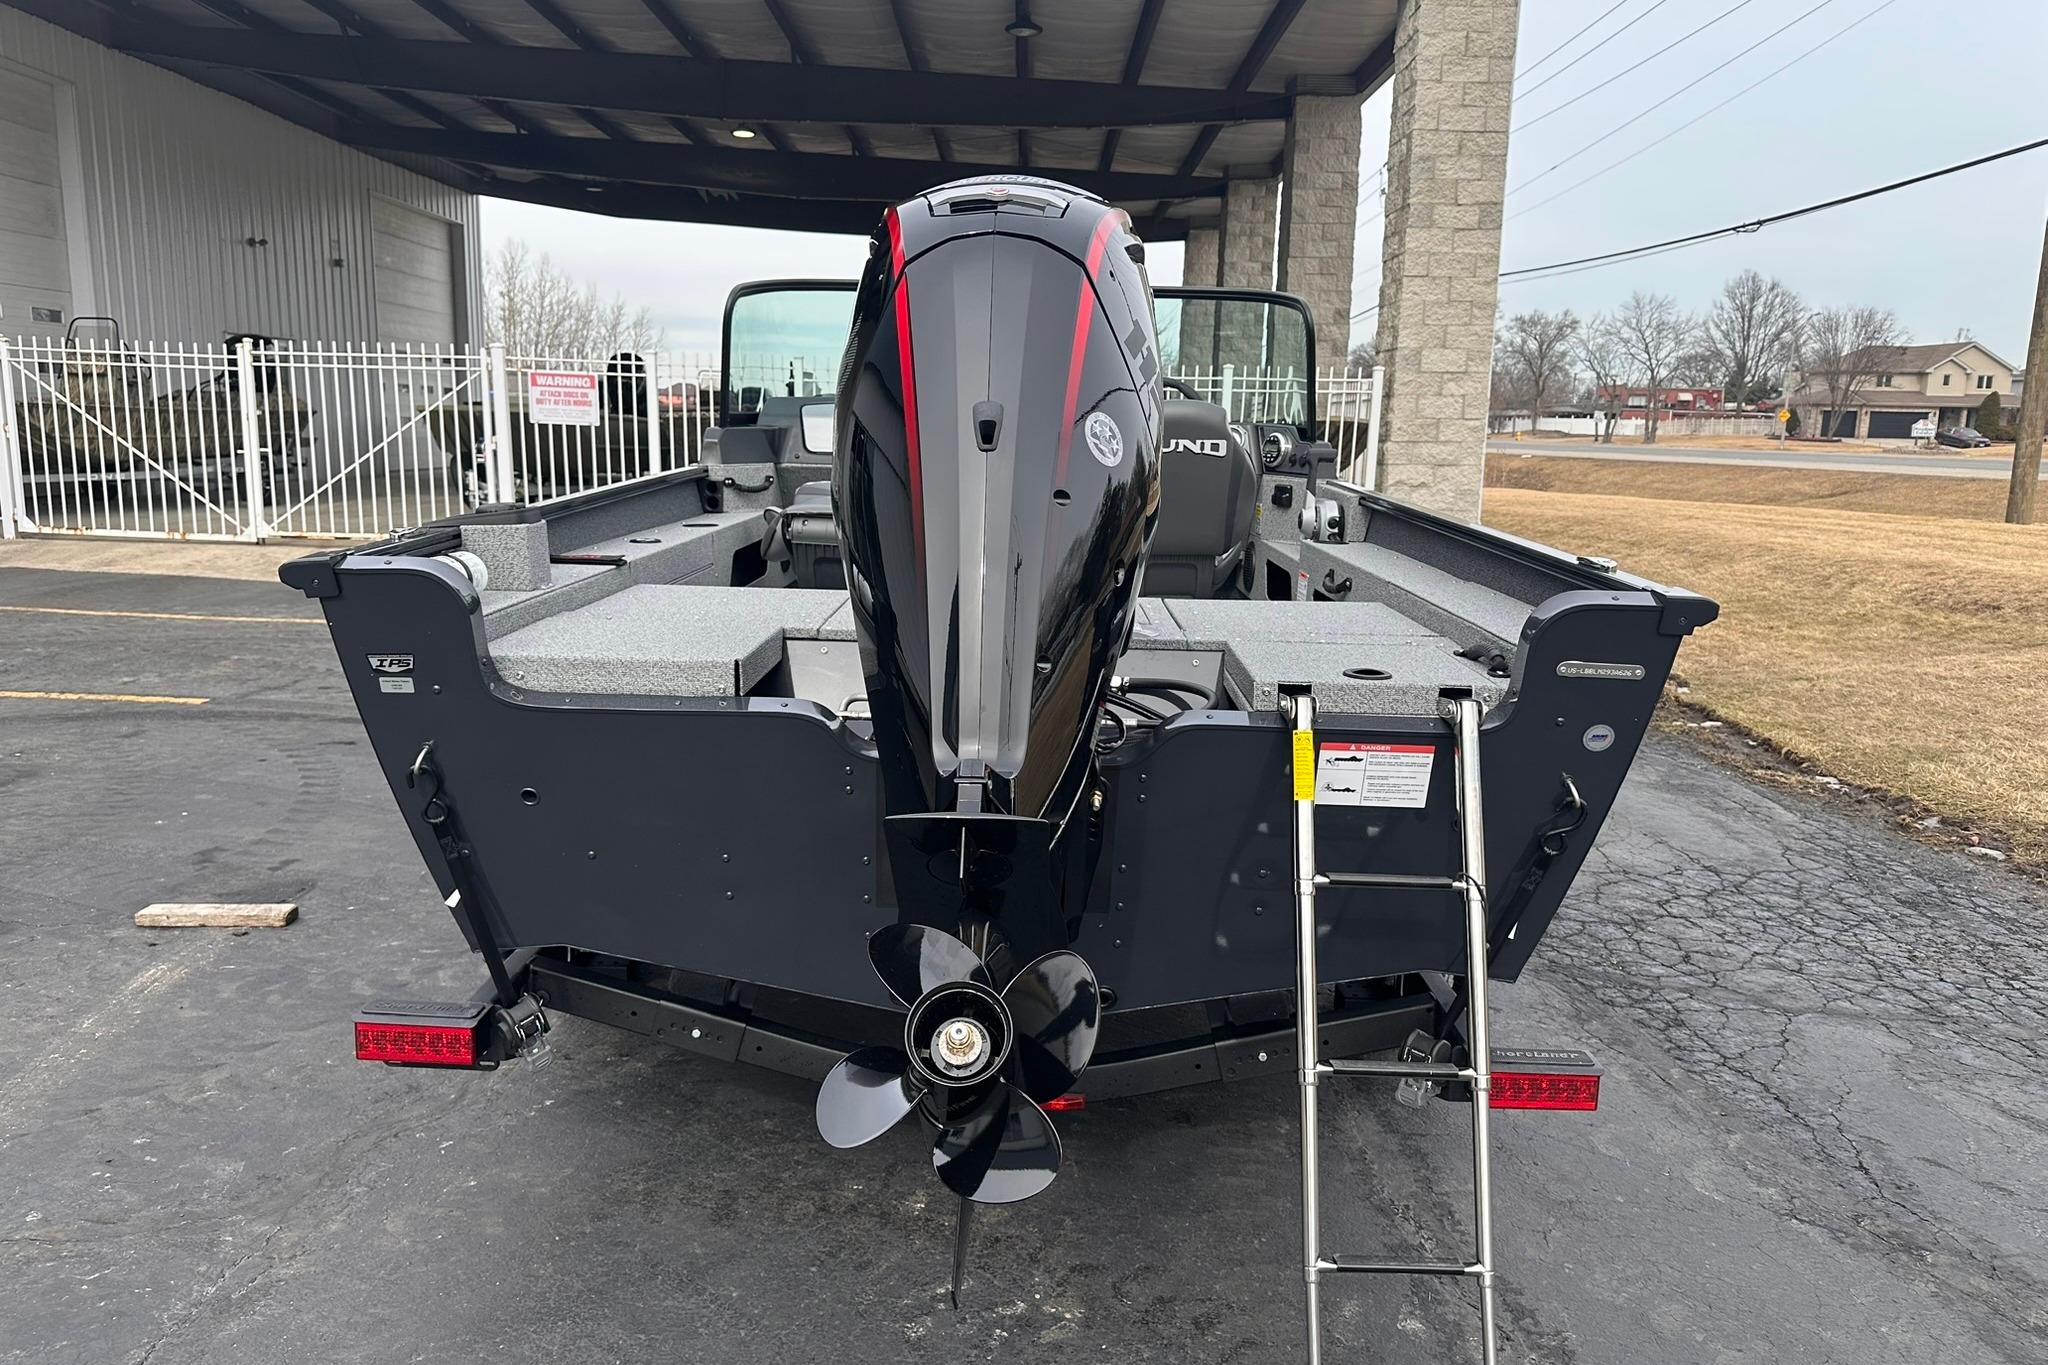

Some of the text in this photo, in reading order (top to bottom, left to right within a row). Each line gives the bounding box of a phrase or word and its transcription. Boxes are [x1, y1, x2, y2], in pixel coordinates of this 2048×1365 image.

[535, 375, 591, 388] WARNING
[540, 390, 561, 398] ATTACK
[553, 399, 571, 407] AFTER
[1162, 439, 1227, 457] UND
[375, 658, 412, 668] IPS
[1360, 744, 1392, 752] DANGER
